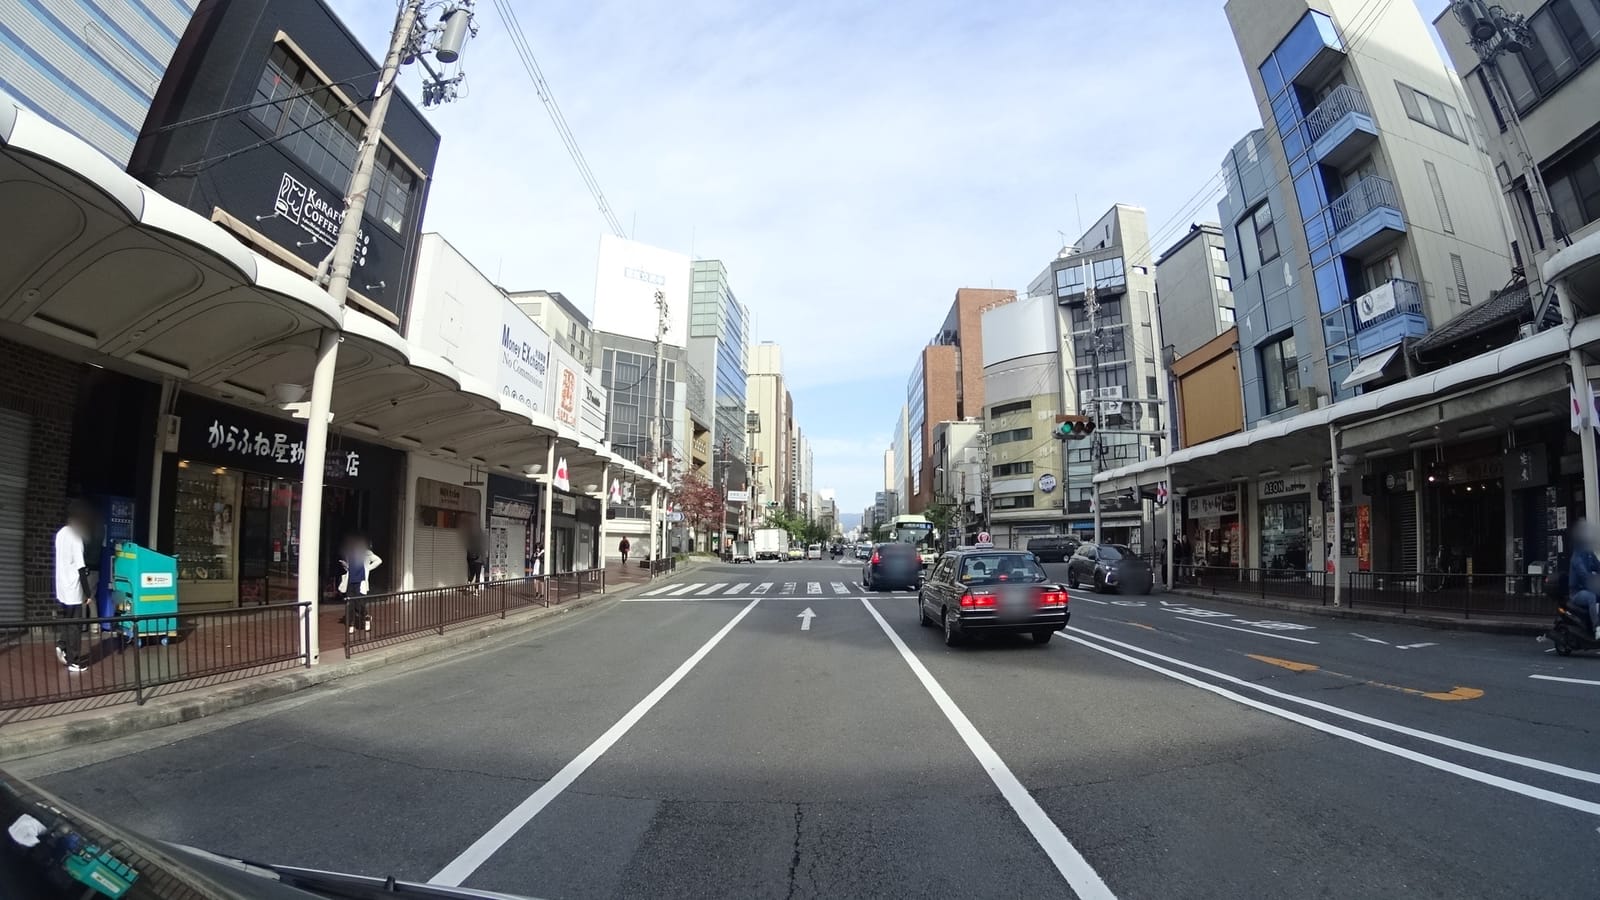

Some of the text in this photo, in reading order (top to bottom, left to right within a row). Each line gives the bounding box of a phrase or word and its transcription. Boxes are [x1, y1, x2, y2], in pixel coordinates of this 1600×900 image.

[304, 203, 339, 236] COFFEE
[307, 188, 363, 240] KARAFUA
[502, 324, 520, 358] Money
[521, 342, 545, 375] EXchange
[502, 351, 513, 368] No
[208, 419, 360, 477] からふね屋珈店
[1264, 479, 1285, 496] AEON
